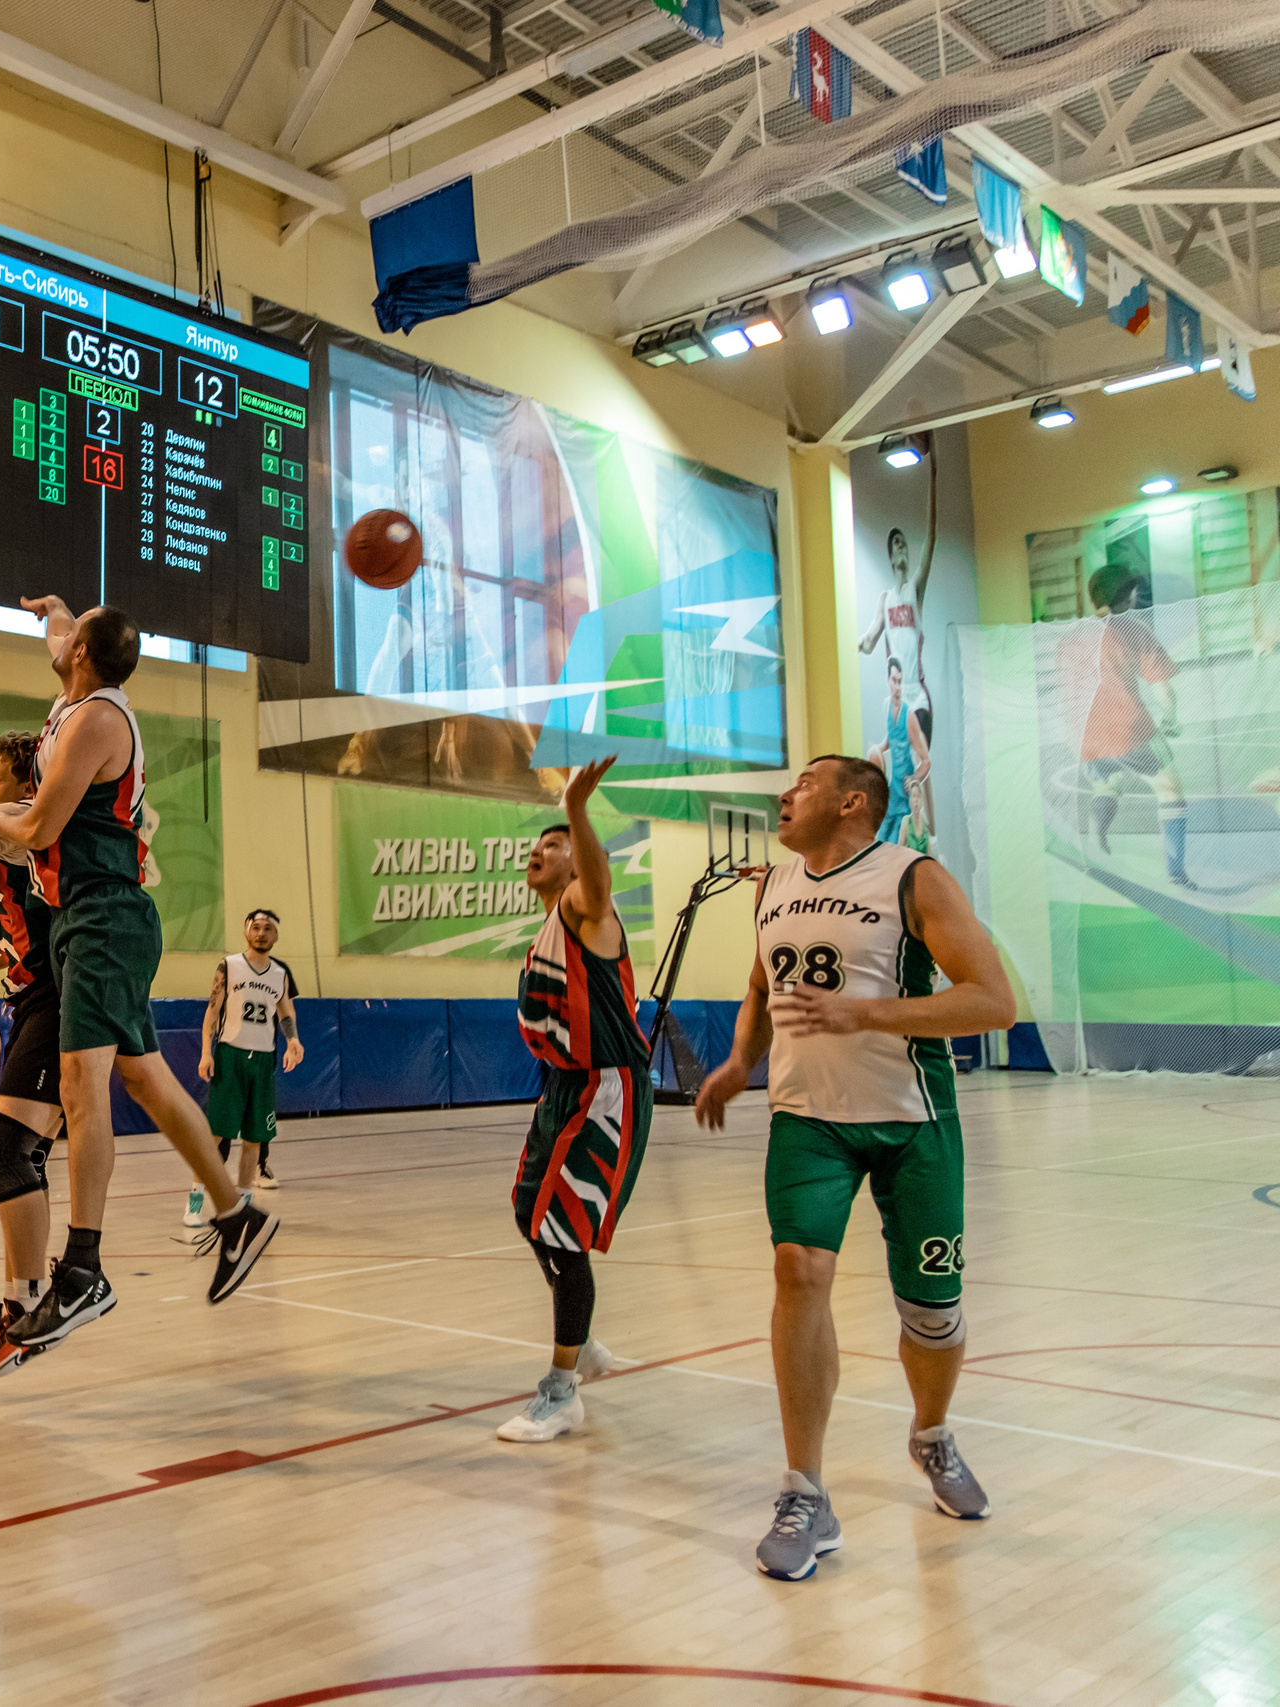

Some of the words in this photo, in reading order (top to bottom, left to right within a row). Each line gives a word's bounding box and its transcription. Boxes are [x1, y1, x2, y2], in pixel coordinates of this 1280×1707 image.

[67, 330, 140, 380] 05:50
[185, 325, 238, 362] Янгпур
[49, 395, 57, 409] 3
[74, 375, 133, 408] ПЕРИОД
[194, 371, 223, 408] 12
[49, 414, 57, 427] 2
[96, 409, 111, 436] 2
[49, 432, 57, 446] 4
[140, 422, 154, 438] 20
[164, 428, 206, 453] Дерягин
[140, 439, 154, 455] 22
[267, 429, 277, 448] 4
[49, 450, 57, 464] 4
[91, 455, 117, 482] 16
[48, 468, 56, 482] 8
[140, 457, 154, 472] 23
[164, 463, 222, 491] Хабибуллин
[140, 475, 154, 489] 24
[45, 487, 59, 501] 20
[140, 492, 154, 507] 27
[140, 510, 154, 525] 28
[165, 515, 227, 543] Кондратенко
[140, 528, 154, 543] 29
[164, 534, 209, 556] Лифанов
[165, 551, 201, 573] Кравец
[371, 837, 477, 875] ЖИЗНЬ
[482, 836, 539, 873] ТРЕ
[372, 880, 538, 923] ДВИЖЕНИЯ!
[760, 903, 785, 931] НК
[787, 897, 881, 924] ЯНГПУР
[768, 941, 846, 995] 28
[242, 1000, 268, 1024] 23
